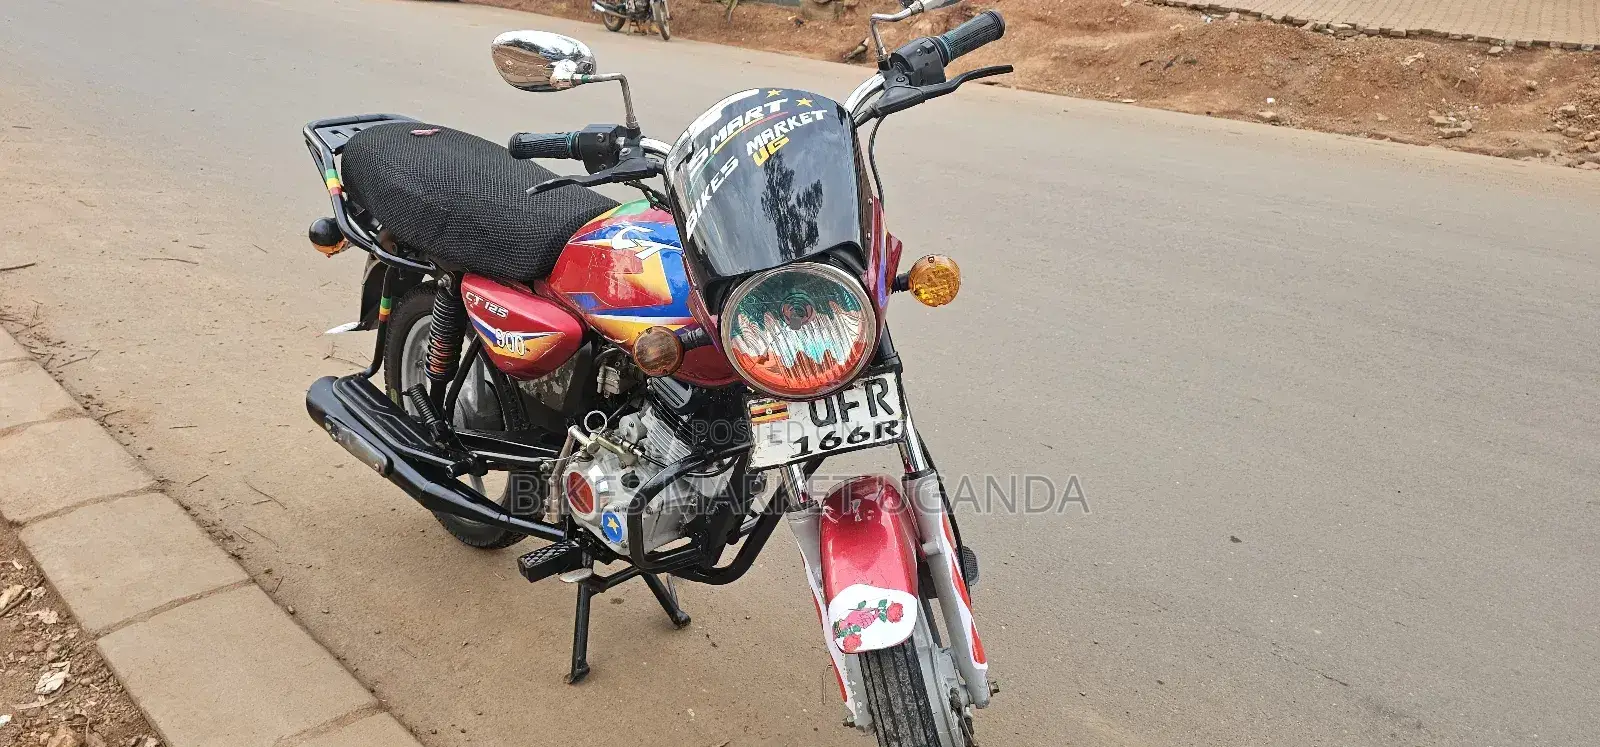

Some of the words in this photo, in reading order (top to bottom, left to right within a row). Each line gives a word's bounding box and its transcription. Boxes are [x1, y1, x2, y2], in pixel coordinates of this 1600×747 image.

[687, 97, 789, 177] SMART
[752, 137, 790, 167] UG
[686, 155, 739, 242] BIKES
[745, 109, 828, 156] MARKET
[464, 290, 484, 307] CT
[484, 300, 509, 319] 125
[494, 328, 526, 357] 900
[808, 377, 896, 428] UFR
[791, 420, 899, 459] 166R
